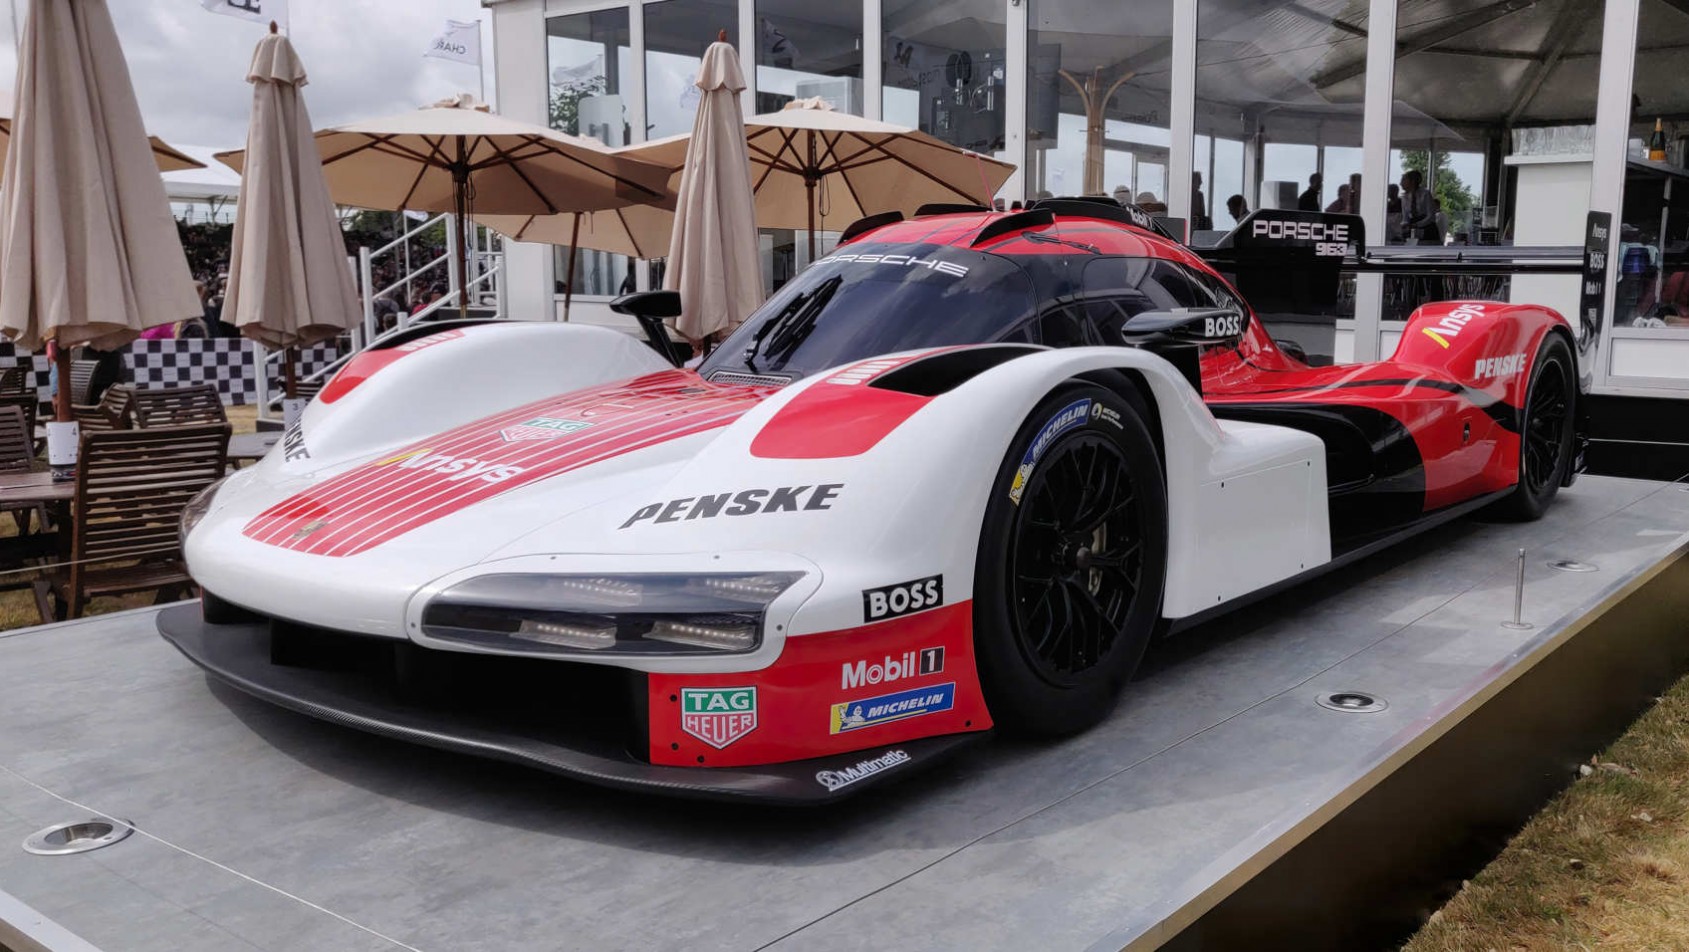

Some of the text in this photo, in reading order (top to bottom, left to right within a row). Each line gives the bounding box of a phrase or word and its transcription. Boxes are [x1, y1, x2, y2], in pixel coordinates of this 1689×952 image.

[1253, 219, 1349, 241] PORSCHE
[1315, 242, 1348, 256] 963
[815, 254, 969, 278] ORSCHE
[1205, 316, 1240, 337] BOSS
[1422, 303, 1486, 349] Ansys
[1474, 353, 1527, 380] PENSKE
[284, 410, 311, 462] NSKE
[529, 418, 580, 431] TAG
[1032, 404, 1089, 461] MICHELIN
[376, 448, 526, 484] Ansys
[617, 483, 845, 531] PENSKE
[869, 579, 940, 618] BOSS
[841, 651, 917, 690] Mobil
[688, 691, 750, 711] TAG
[867, 692, 945, 719] MICHELIN
[687, 714, 753, 744] HEUER
[837, 750, 909, 782] Multimatic
